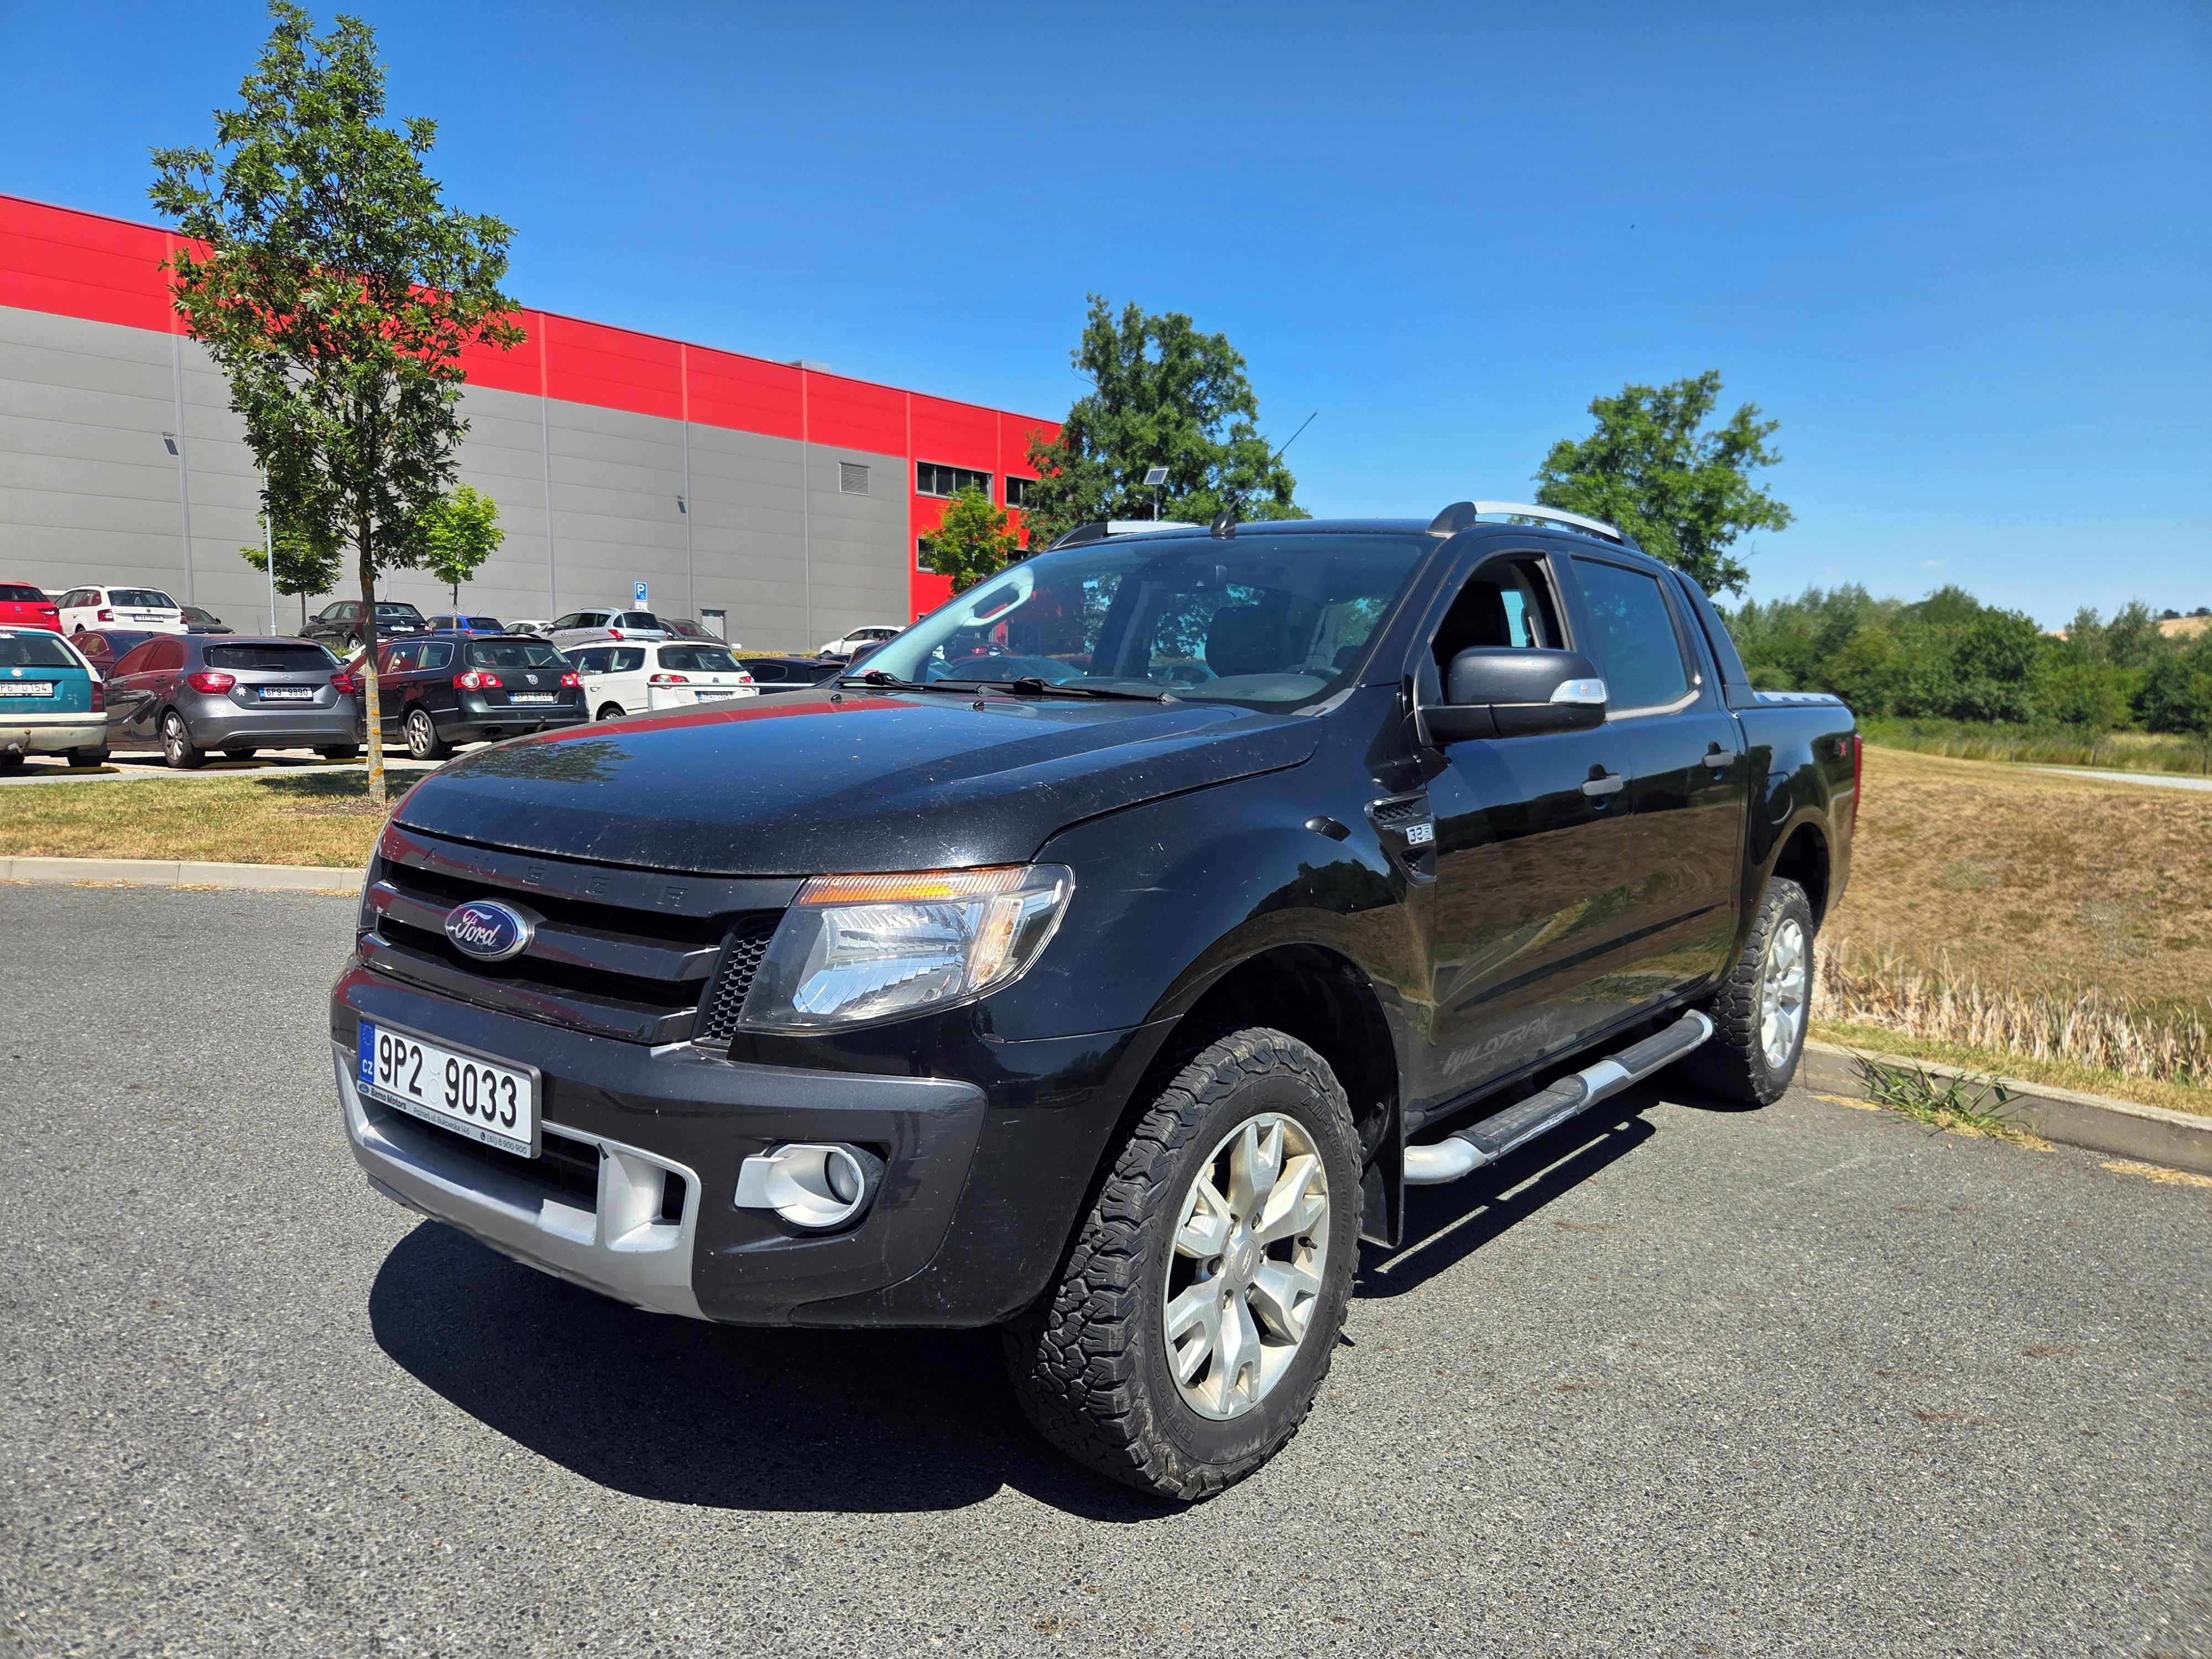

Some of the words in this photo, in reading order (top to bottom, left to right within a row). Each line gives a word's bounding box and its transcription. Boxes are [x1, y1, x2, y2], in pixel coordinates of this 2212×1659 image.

[637, 584, 645, 595] P
[266, 688, 282, 696] 6P9
[288, 688, 308, 696] 9890
[384, 835, 688, 907] RANGER
[455, 909, 502, 946] Ford
[1442, 1012, 1555, 1076] WILDTRAK
[362, 1058, 373, 1075] CZ
[379, 1034, 422, 1097] 9P2
[445, 1057, 517, 1128] 9033
[371, 1087, 387, 1102] Bemo
[387, 1094, 407, 1110] Motors
